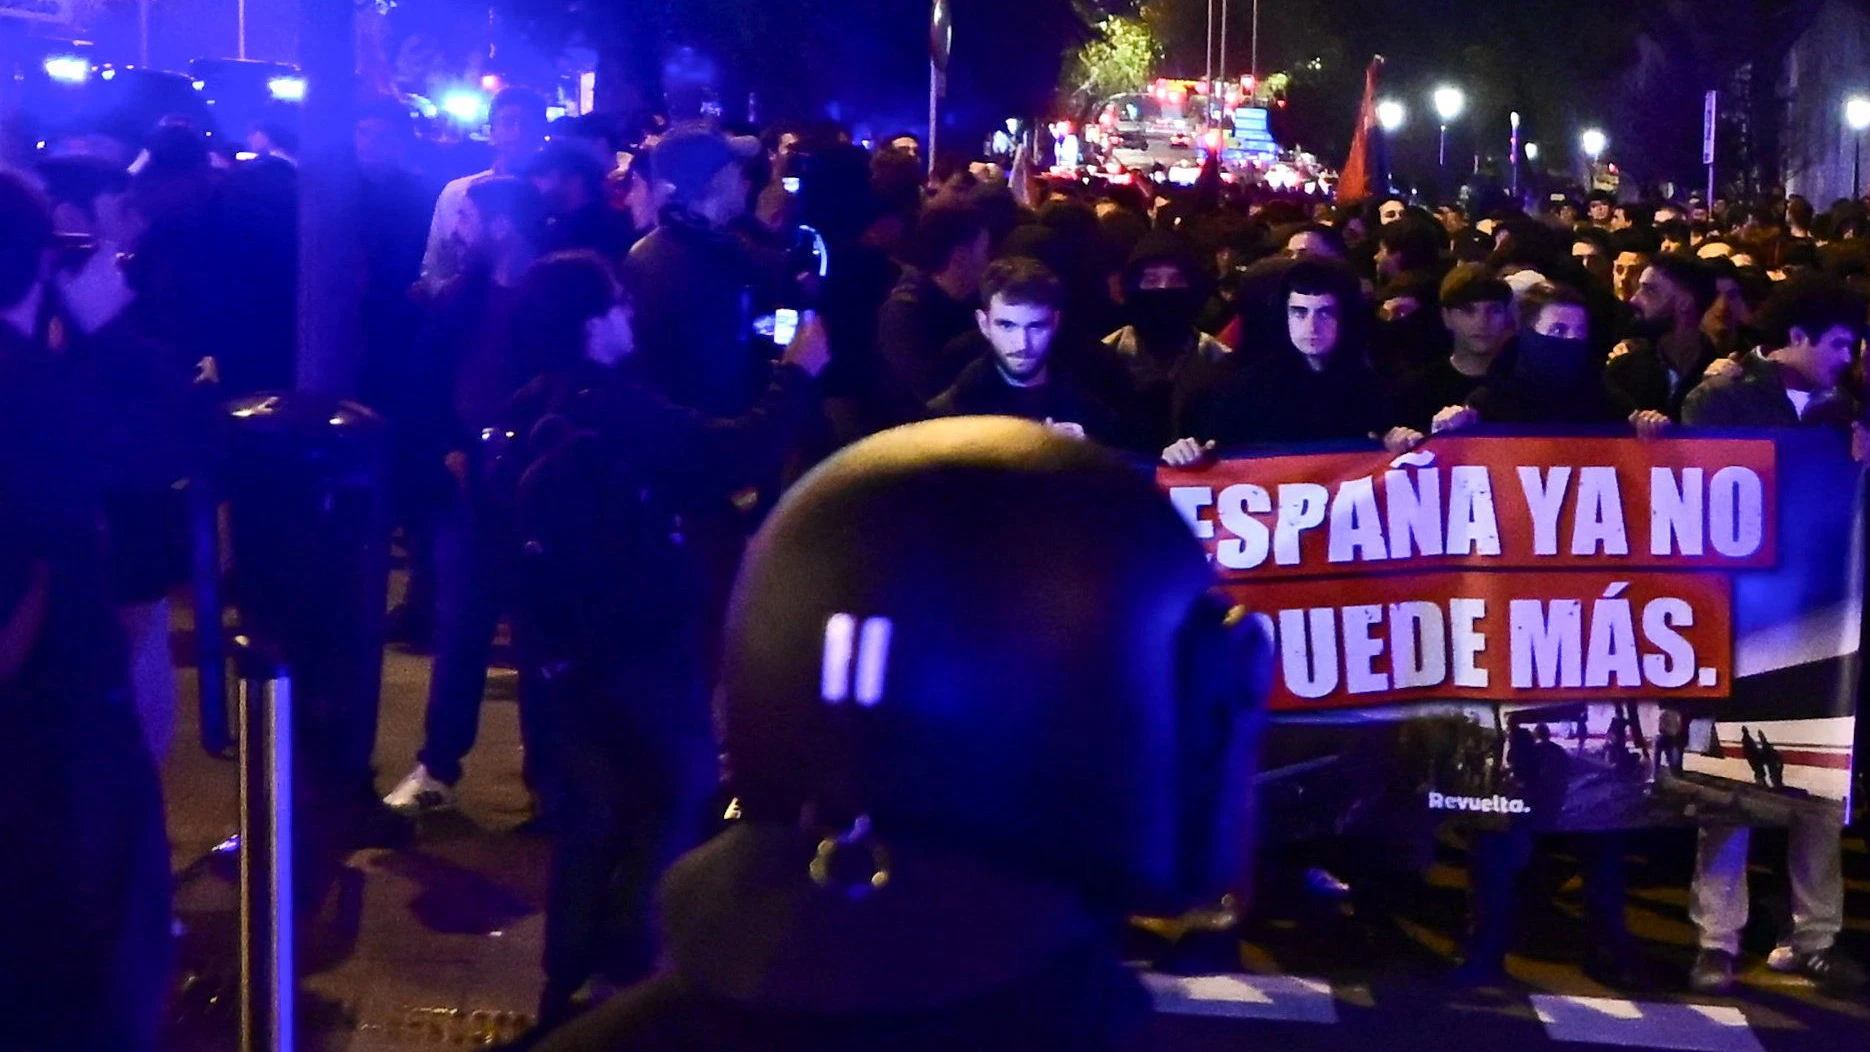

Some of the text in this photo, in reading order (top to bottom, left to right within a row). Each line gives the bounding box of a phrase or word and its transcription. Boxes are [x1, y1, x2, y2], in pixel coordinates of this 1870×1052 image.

[1168, 450, 1764, 569] ESPAÑA YA NO
[1262, 580, 1718, 699] UEDE MÁS.
